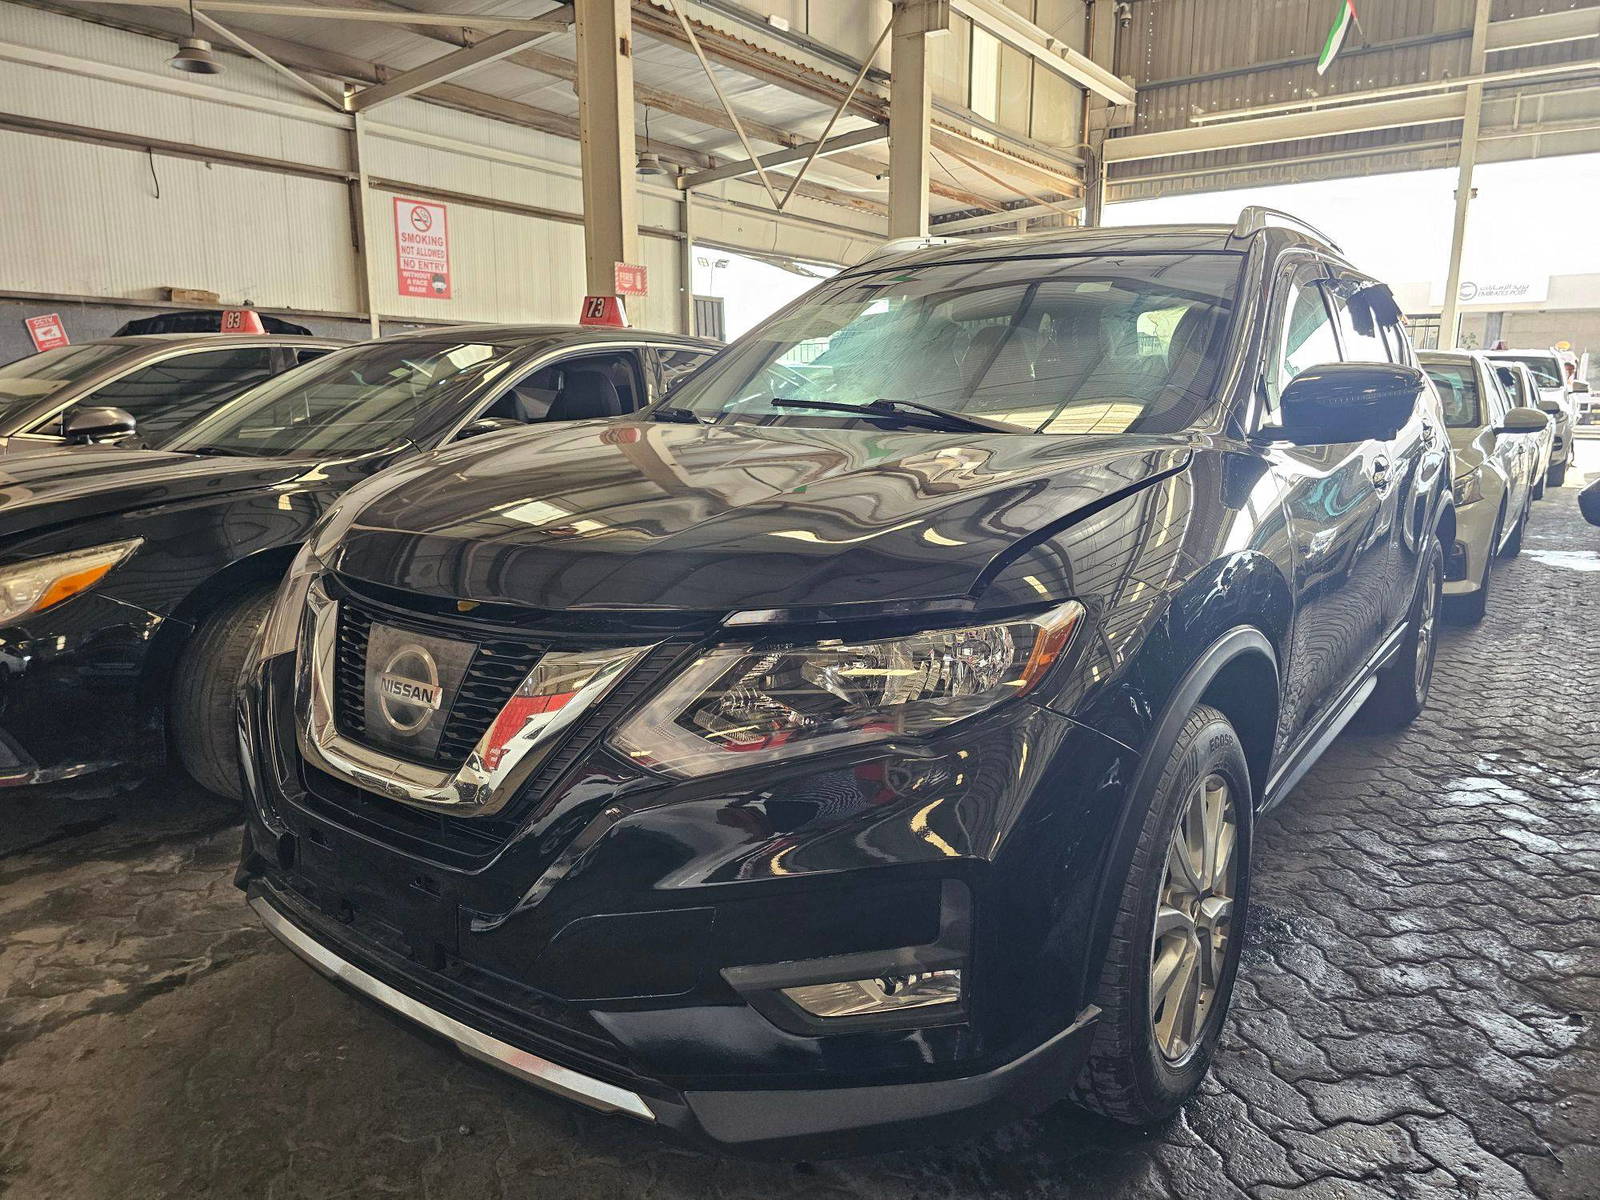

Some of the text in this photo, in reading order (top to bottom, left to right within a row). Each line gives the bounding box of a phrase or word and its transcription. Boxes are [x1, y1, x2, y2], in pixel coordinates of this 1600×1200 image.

[401, 232, 444, 247] SMOKING
[401, 245, 445, 259] NOT ALLOWED
[403, 258, 445, 271] NO ENTRY
[402, 271, 431, 280] WITHOUT
[587, 297, 605, 318] 73
[227, 312, 241, 329] 83
[381, 678, 434, 703] NISSAN
